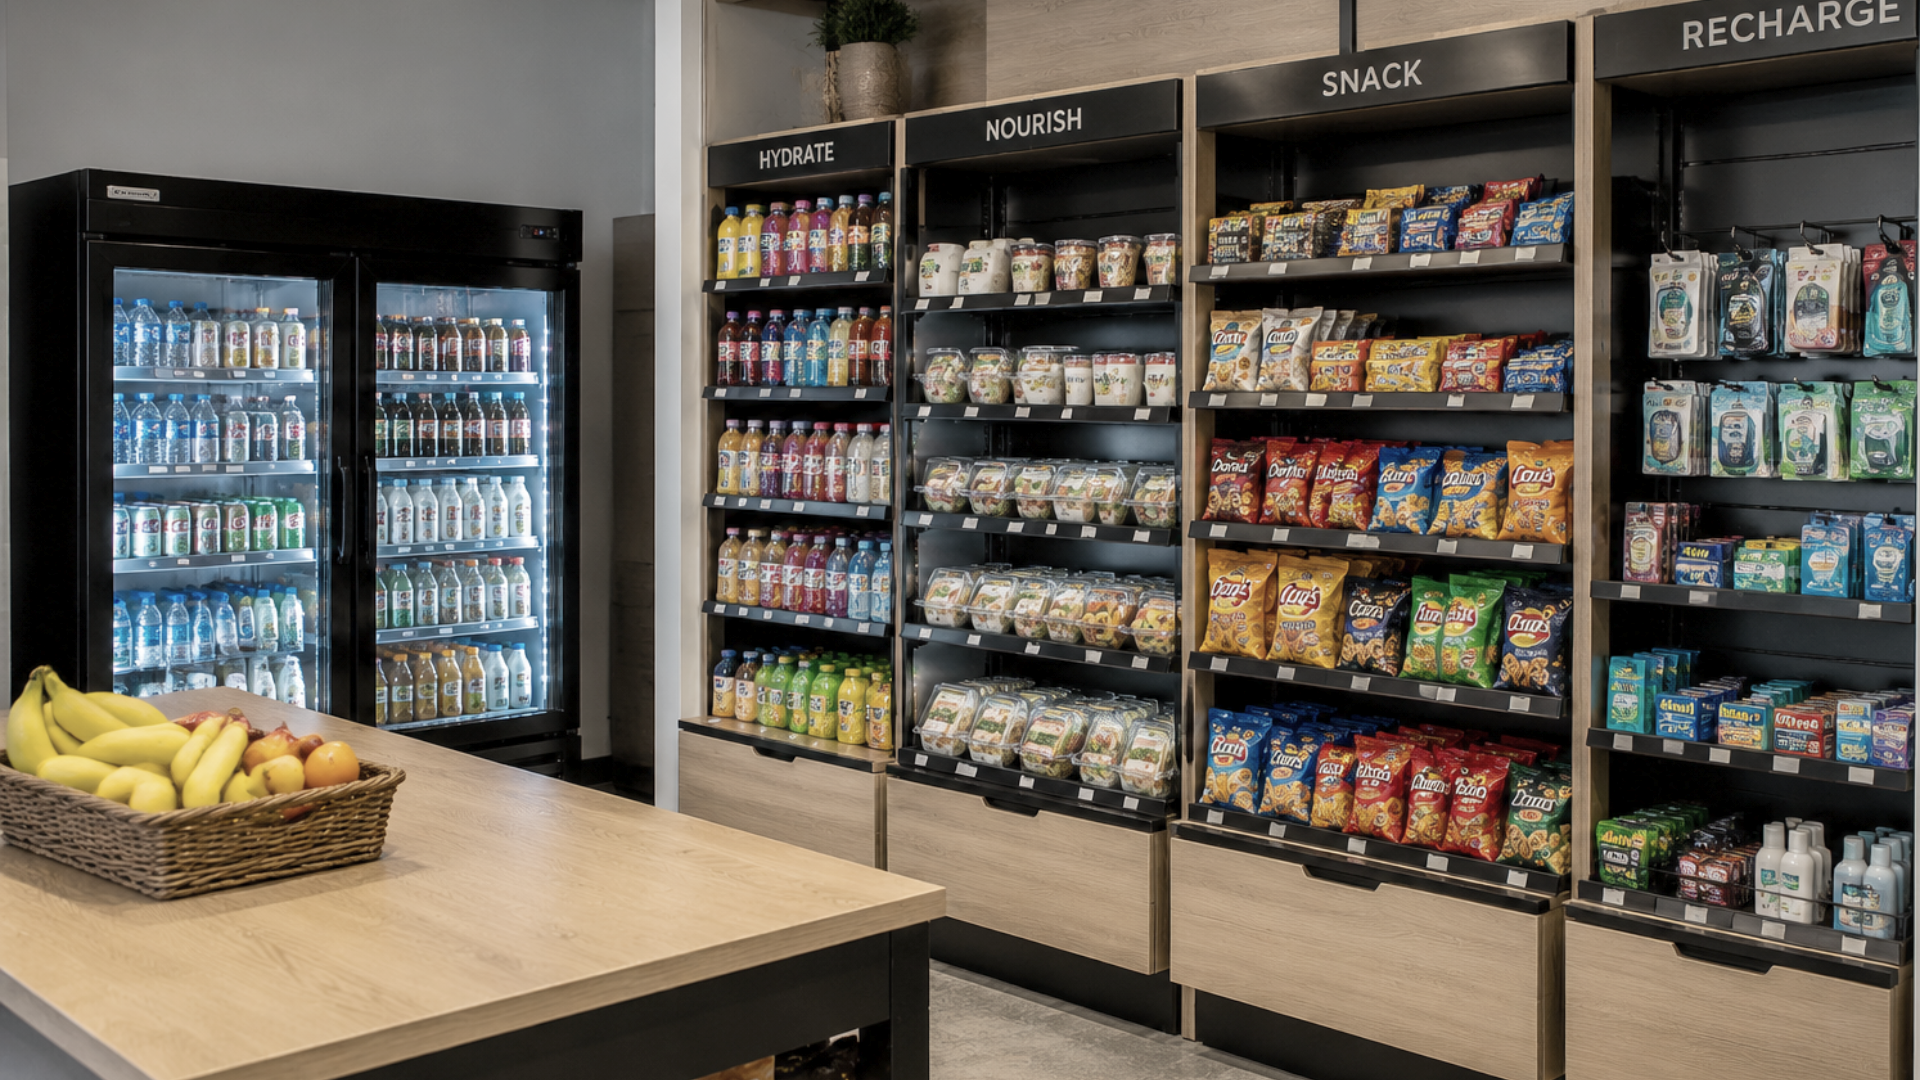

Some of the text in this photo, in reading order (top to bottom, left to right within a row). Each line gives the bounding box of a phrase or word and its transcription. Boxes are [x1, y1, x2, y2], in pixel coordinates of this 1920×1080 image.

[1682, 0, 1901, 51] RECHARGE
[1322, 58, 1423, 97] SNACK
[986, 107, 1082, 142] NOURISH
[759, 141, 835, 171] HYDRATE
